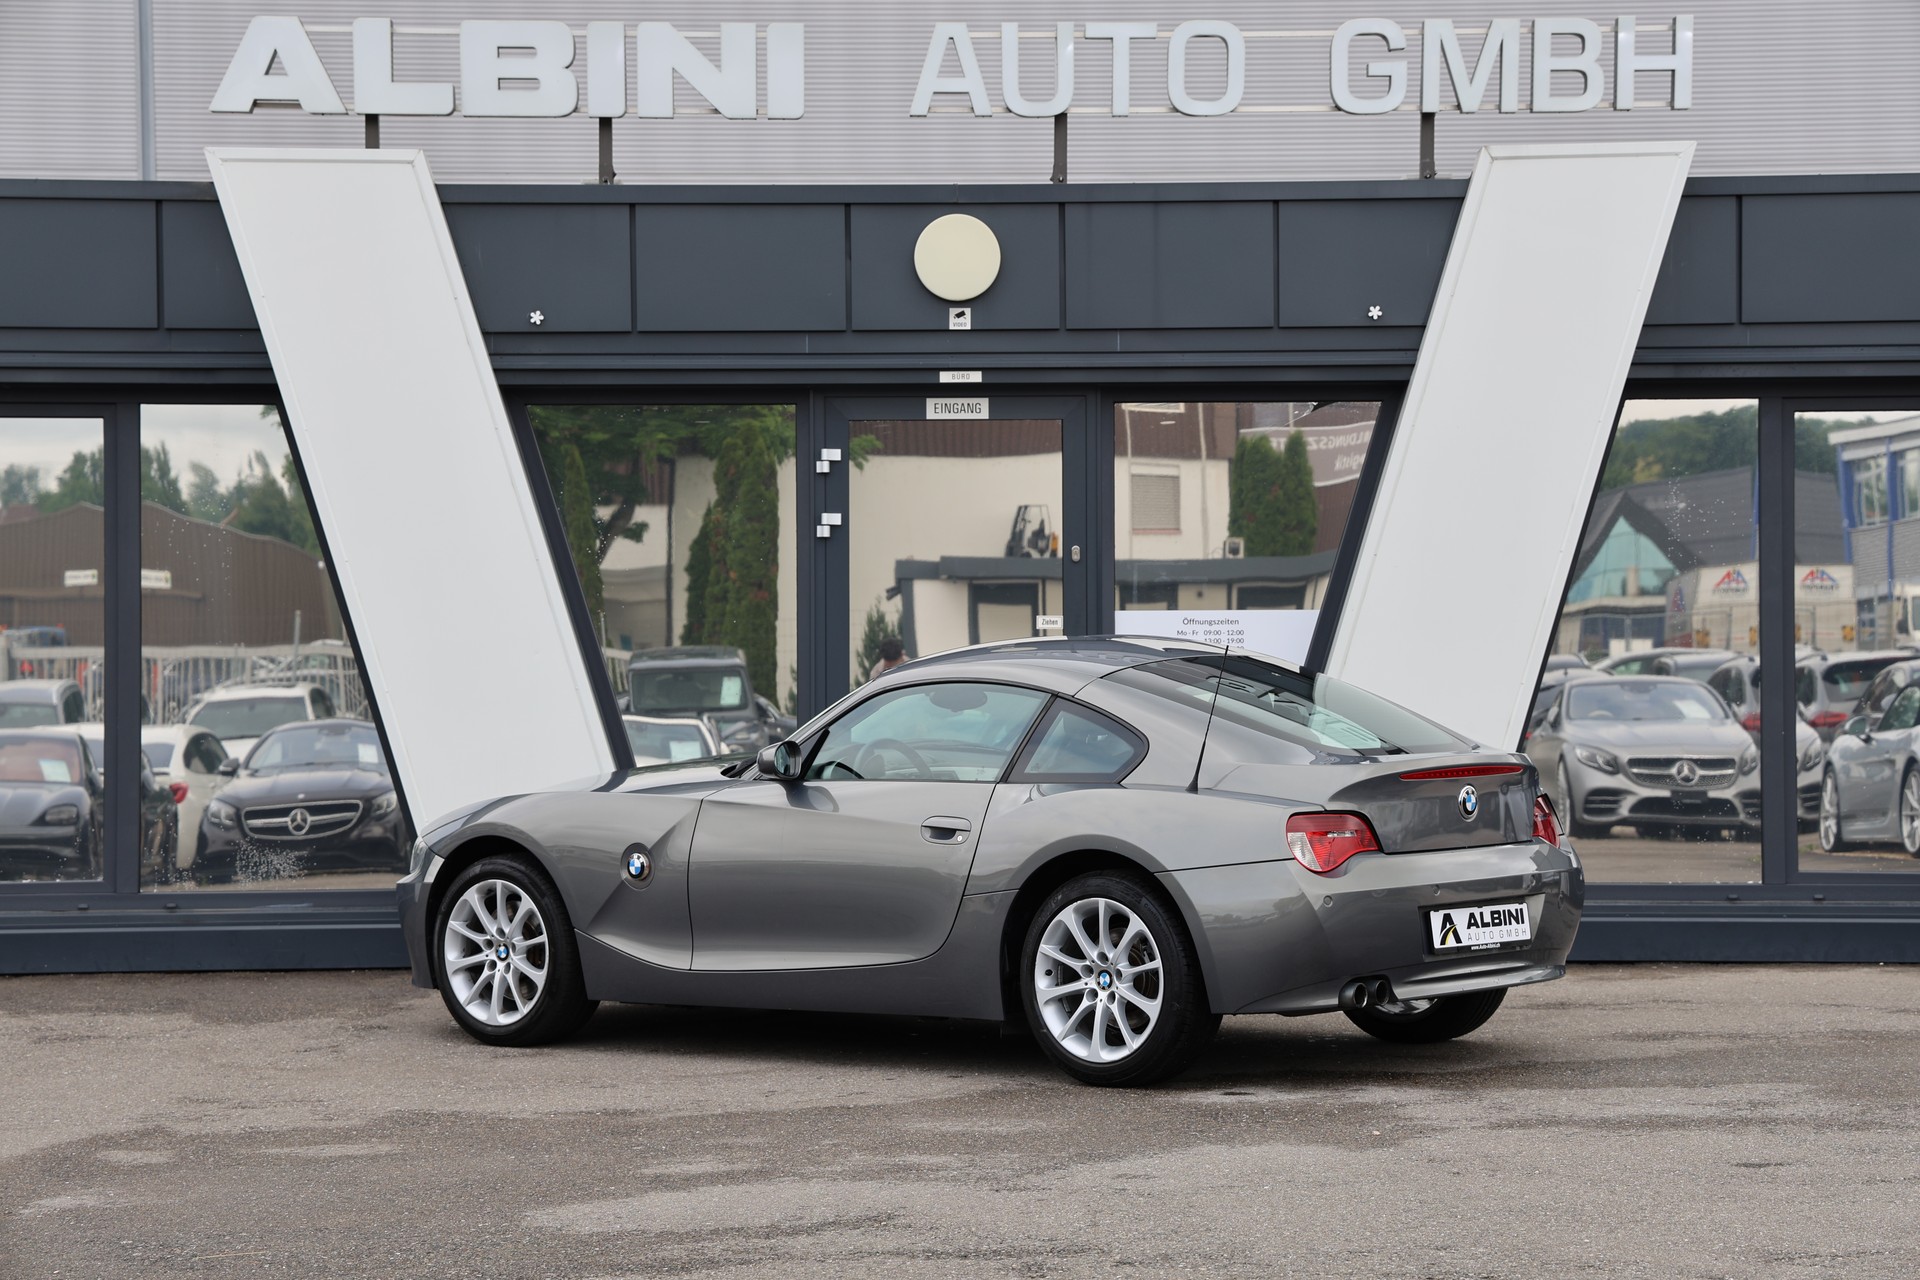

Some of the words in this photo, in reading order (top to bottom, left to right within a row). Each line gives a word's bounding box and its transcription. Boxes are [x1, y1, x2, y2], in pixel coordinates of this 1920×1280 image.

[209, 16, 804, 119] ALBINI
[908, 19, 1245, 117] AUTO
[1330, 14, 1694, 116] GMBH
[952, 372, 970, 380] BÜRO
[933, 402, 982, 414] EINGANG
[1182, 617, 1240, 626] Öffnungszeiten
[1466, 908, 1525, 930] ALBINI
[1467, 930, 1495, 942] AUTO
[1499, 928, 1527, 939] GMBH
